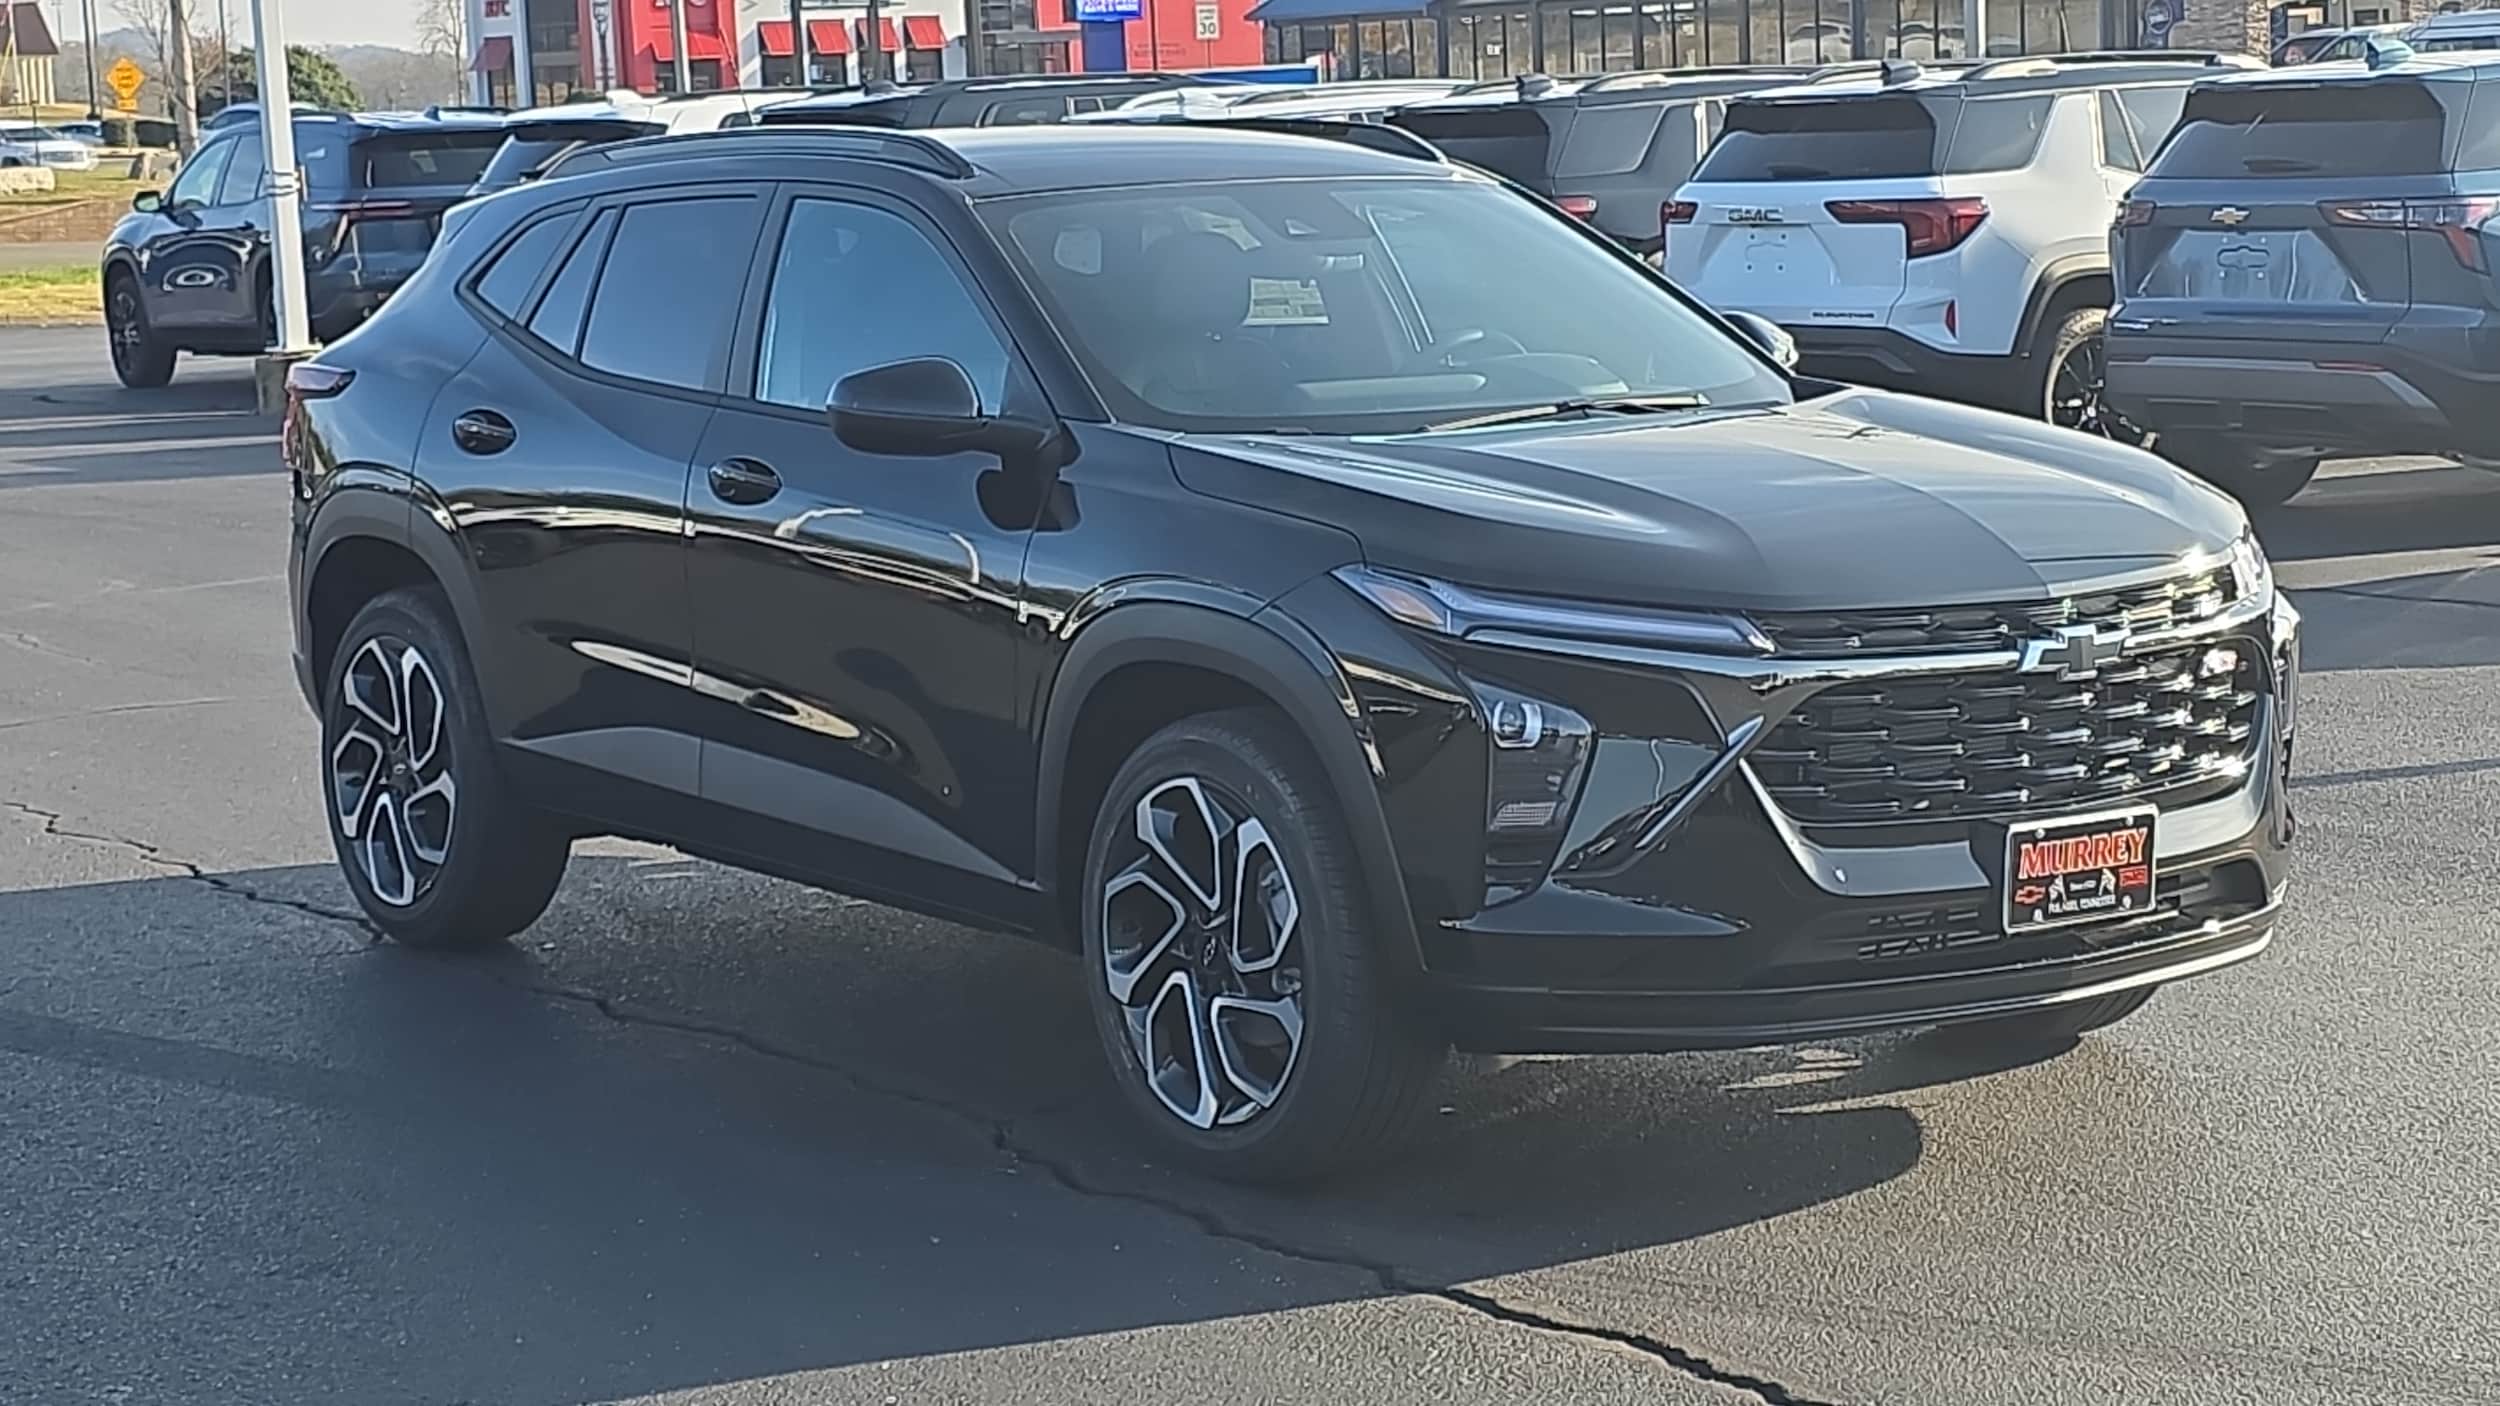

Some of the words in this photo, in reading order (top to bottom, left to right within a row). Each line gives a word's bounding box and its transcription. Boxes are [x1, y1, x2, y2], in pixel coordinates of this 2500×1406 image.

[1199, 22, 1217, 35] 30
[1728, 208, 1784, 222] GMC
[2018, 827, 2148, 879] MURREY
